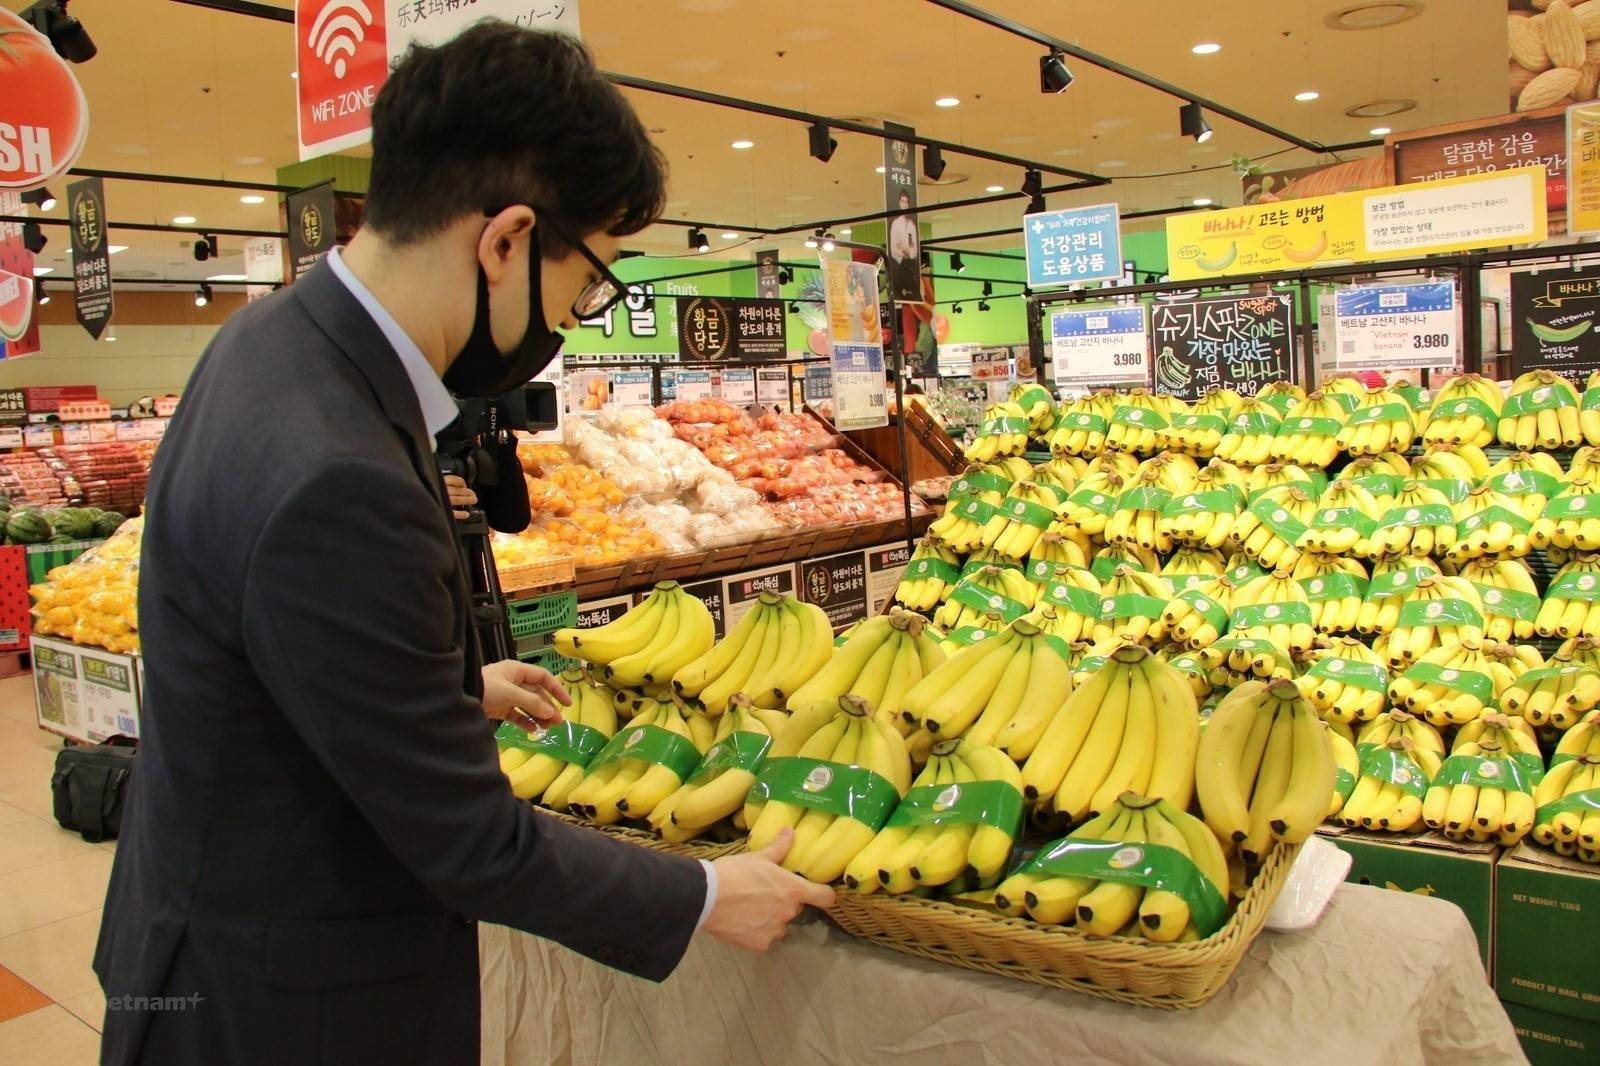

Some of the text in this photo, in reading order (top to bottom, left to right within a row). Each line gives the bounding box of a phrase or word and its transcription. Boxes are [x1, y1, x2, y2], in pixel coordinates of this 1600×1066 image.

[338, 84, 376, 118] ZONE
[1443, 138, 1495, 165] 달콤한
[1500, 132, 1537, 157] 감을
[1203, 204, 1325, 233] 바나나! 고르는 방법
[1041, 230, 1103, 256] 건강관리
[1042, 253, 1106, 276] 도움상품
[666, 282, 699, 296] Fruits
[1560, 282, 1594, 294] 바나나
[694, 307, 719, 330] 황금
[739, 306, 782, 320] 차원이 다른
[1340, 314, 1427, 328] 베트남 고산지 바나나
[739, 322, 782, 336] 당도의 품격
[1157, 302, 1286, 341] 슈가스팟 ZONE
[694, 330, 721, 352] 당도
[1102, 336, 1124, 344] 바나나
[1413, 333, 1449, 349] 3,980
[1113, 352, 1142, 366] 3,980
[1186, 339, 1272, 365] 가장 맛있는
[1195, 354, 1286, 383] 지금 바나나
[832, 564, 863, 580] 차원이 다른
[832, 581, 851, 594] 당도의
[1512, 893, 1581, 912] NET WEIGHT 13KG
[1511, 977, 1545, 992] PRODUCT
[1546, 985, 1557, 993] OF
[1532, 1031, 1561, 1044] WEIGHT
